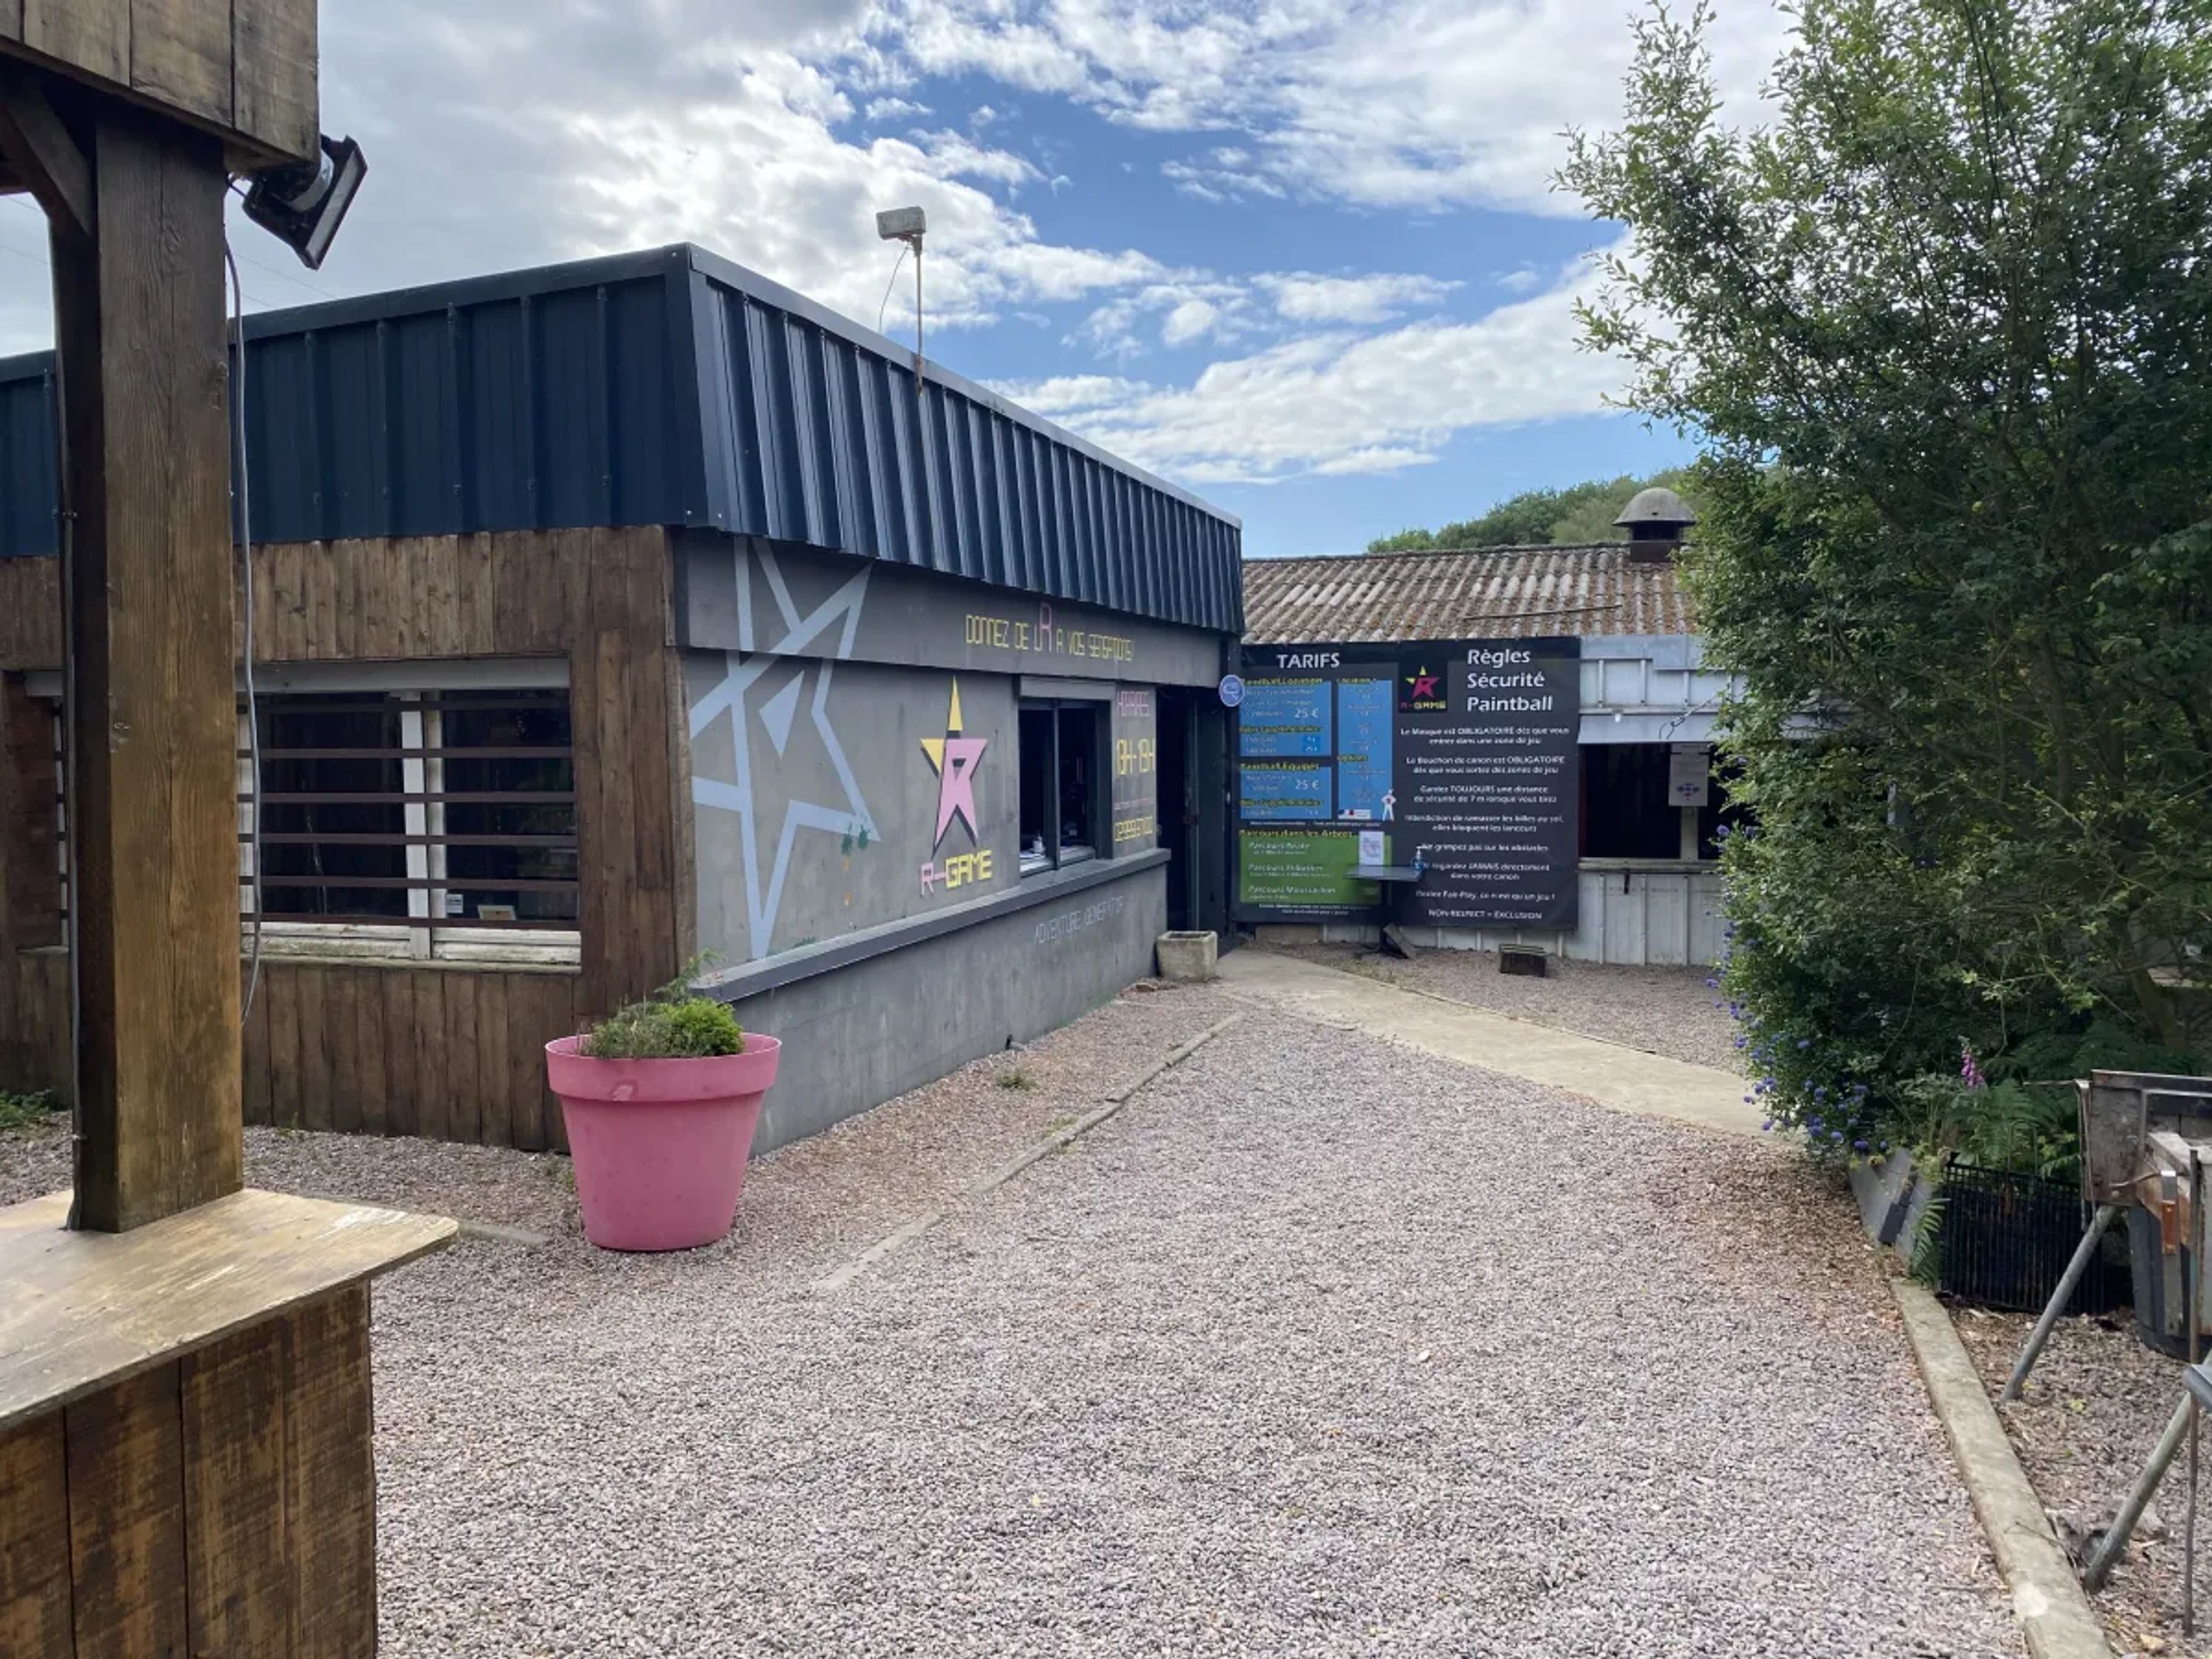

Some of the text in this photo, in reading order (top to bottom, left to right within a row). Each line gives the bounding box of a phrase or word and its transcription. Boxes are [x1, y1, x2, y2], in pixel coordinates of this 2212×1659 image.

[1015, 622, 1029, 650] DE
[1276, 652, 1340, 669] TARIFS
[1467, 648, 1531, 669] Règles
[1467, 671, 1545, 689] Sécurité
[1467, 695, 1554, 712] Paintball
[1293, 708, 1309, 719] 25
[1312, 707, 1320, 719] €
[1457, 727, 1514, 735] OBLIGATOIRE
[1527, 737, 1542, 746] jeu
[1417, 757, 1453, 765] Bouchon
[1454, 757, 1464, 765] de
[1506, 756, 1565, 765] OBLIGATOIRE
[1543, 767, 1559, 775] jeu
[1295, 779, 1309, 790] 25
[1312, 779, 1320, 790] €
[1450, 785, 1495, 793] TOUJOURS
[919, 849, 992, 896] R-GAME
[1494, 910, 1543, 919] EXCLUSION
